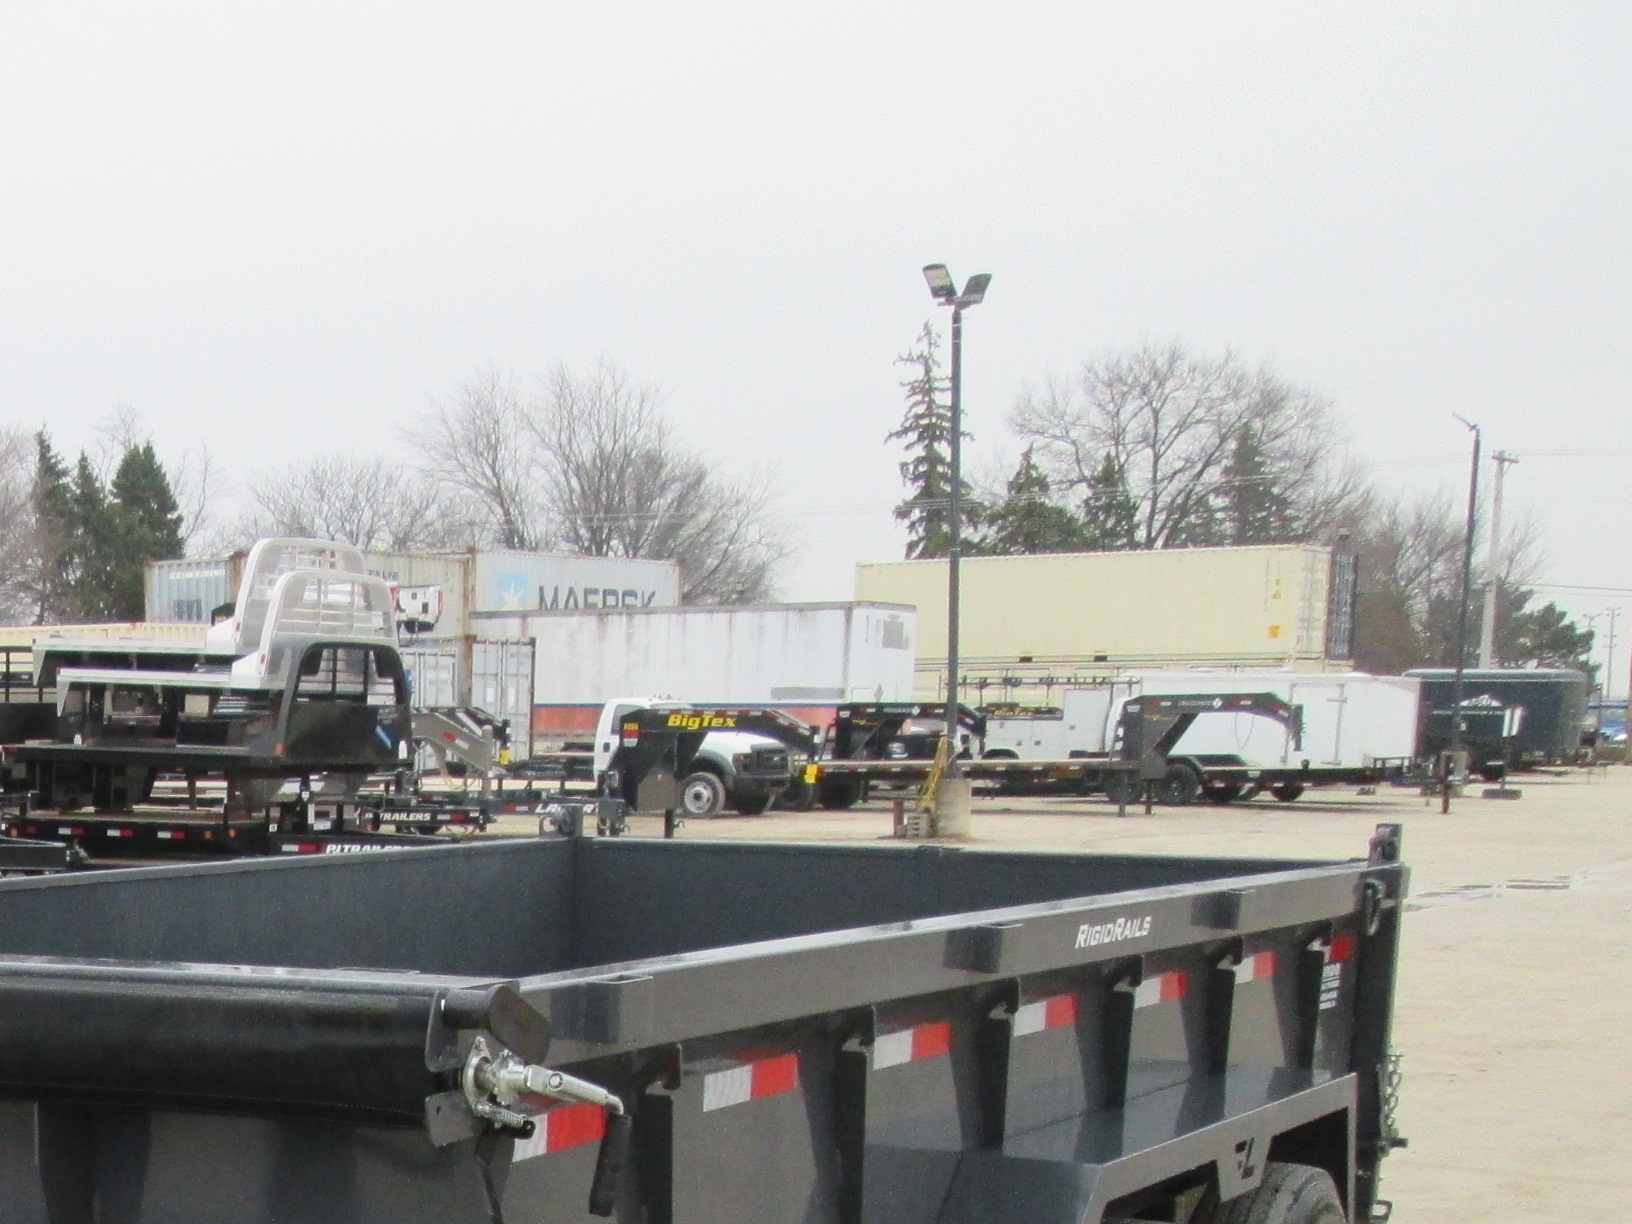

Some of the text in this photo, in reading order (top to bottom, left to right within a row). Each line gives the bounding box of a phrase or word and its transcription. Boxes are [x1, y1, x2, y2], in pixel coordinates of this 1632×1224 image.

[667, 713, 737, 730] BigTex
[535, 803, 596, 814] LAR
[379, 812, 431, 821] TRAILERS
